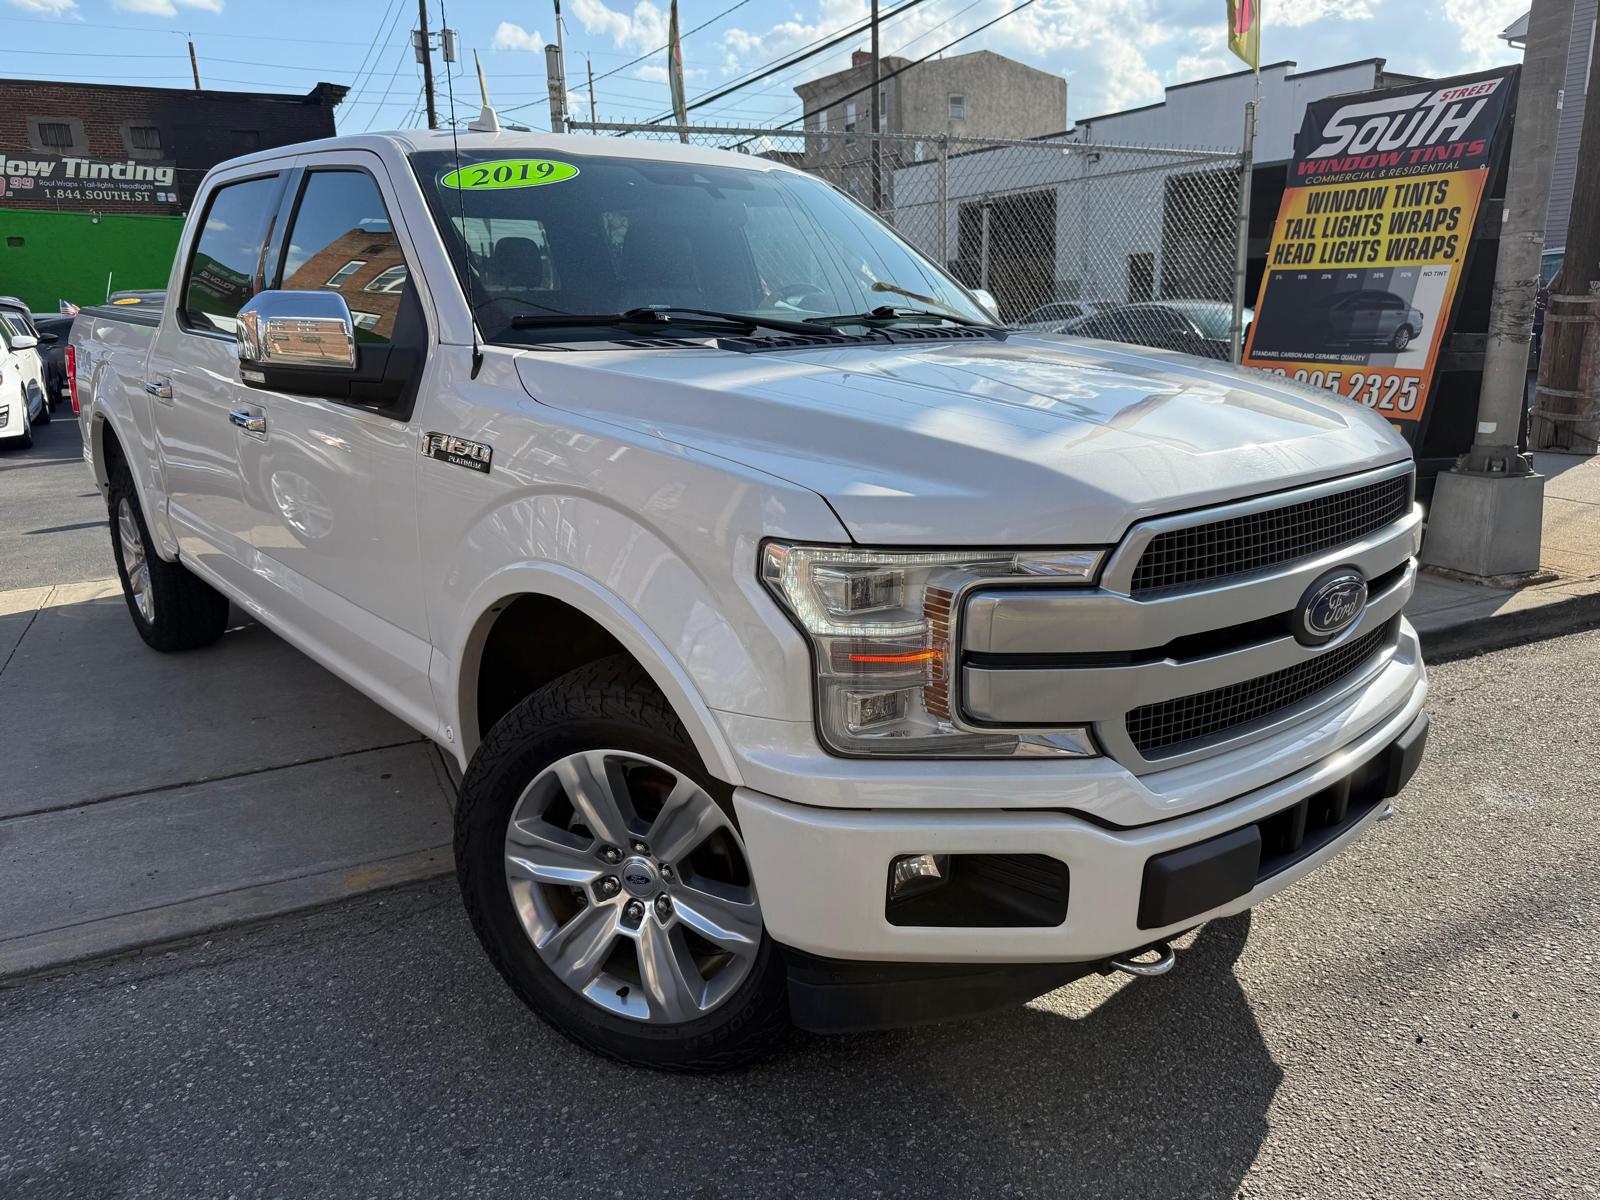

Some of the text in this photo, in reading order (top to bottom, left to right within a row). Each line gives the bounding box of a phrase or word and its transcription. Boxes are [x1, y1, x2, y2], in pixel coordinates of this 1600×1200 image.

[1440, 82, 1497, 102] STREET
[1306, 91, 1489, 158] SOUTH
[1297, 139, 1486, 176] WINDOW TINTS
[61, 158, 175, 187] Tinting
[119, 183, 154, 191] Headlights
[471, 162, 555, 186] 2019
[1305, 160, 1461, 185] COMMERCIAL & RESIDENTIAL
[1305, 179, 1450, 215] WINDOW TINTS
[1284, 206, 1462, 241] TAIL LIGHTS WRAPS
[1273, 234, 1459, 266] HEAD LIGHTS WRAPS
[1280, 351, 1303, 359] CARBON
[448, 455, 482, 469] PLATINUM
[1324, 589, 1359, 625] Ford
